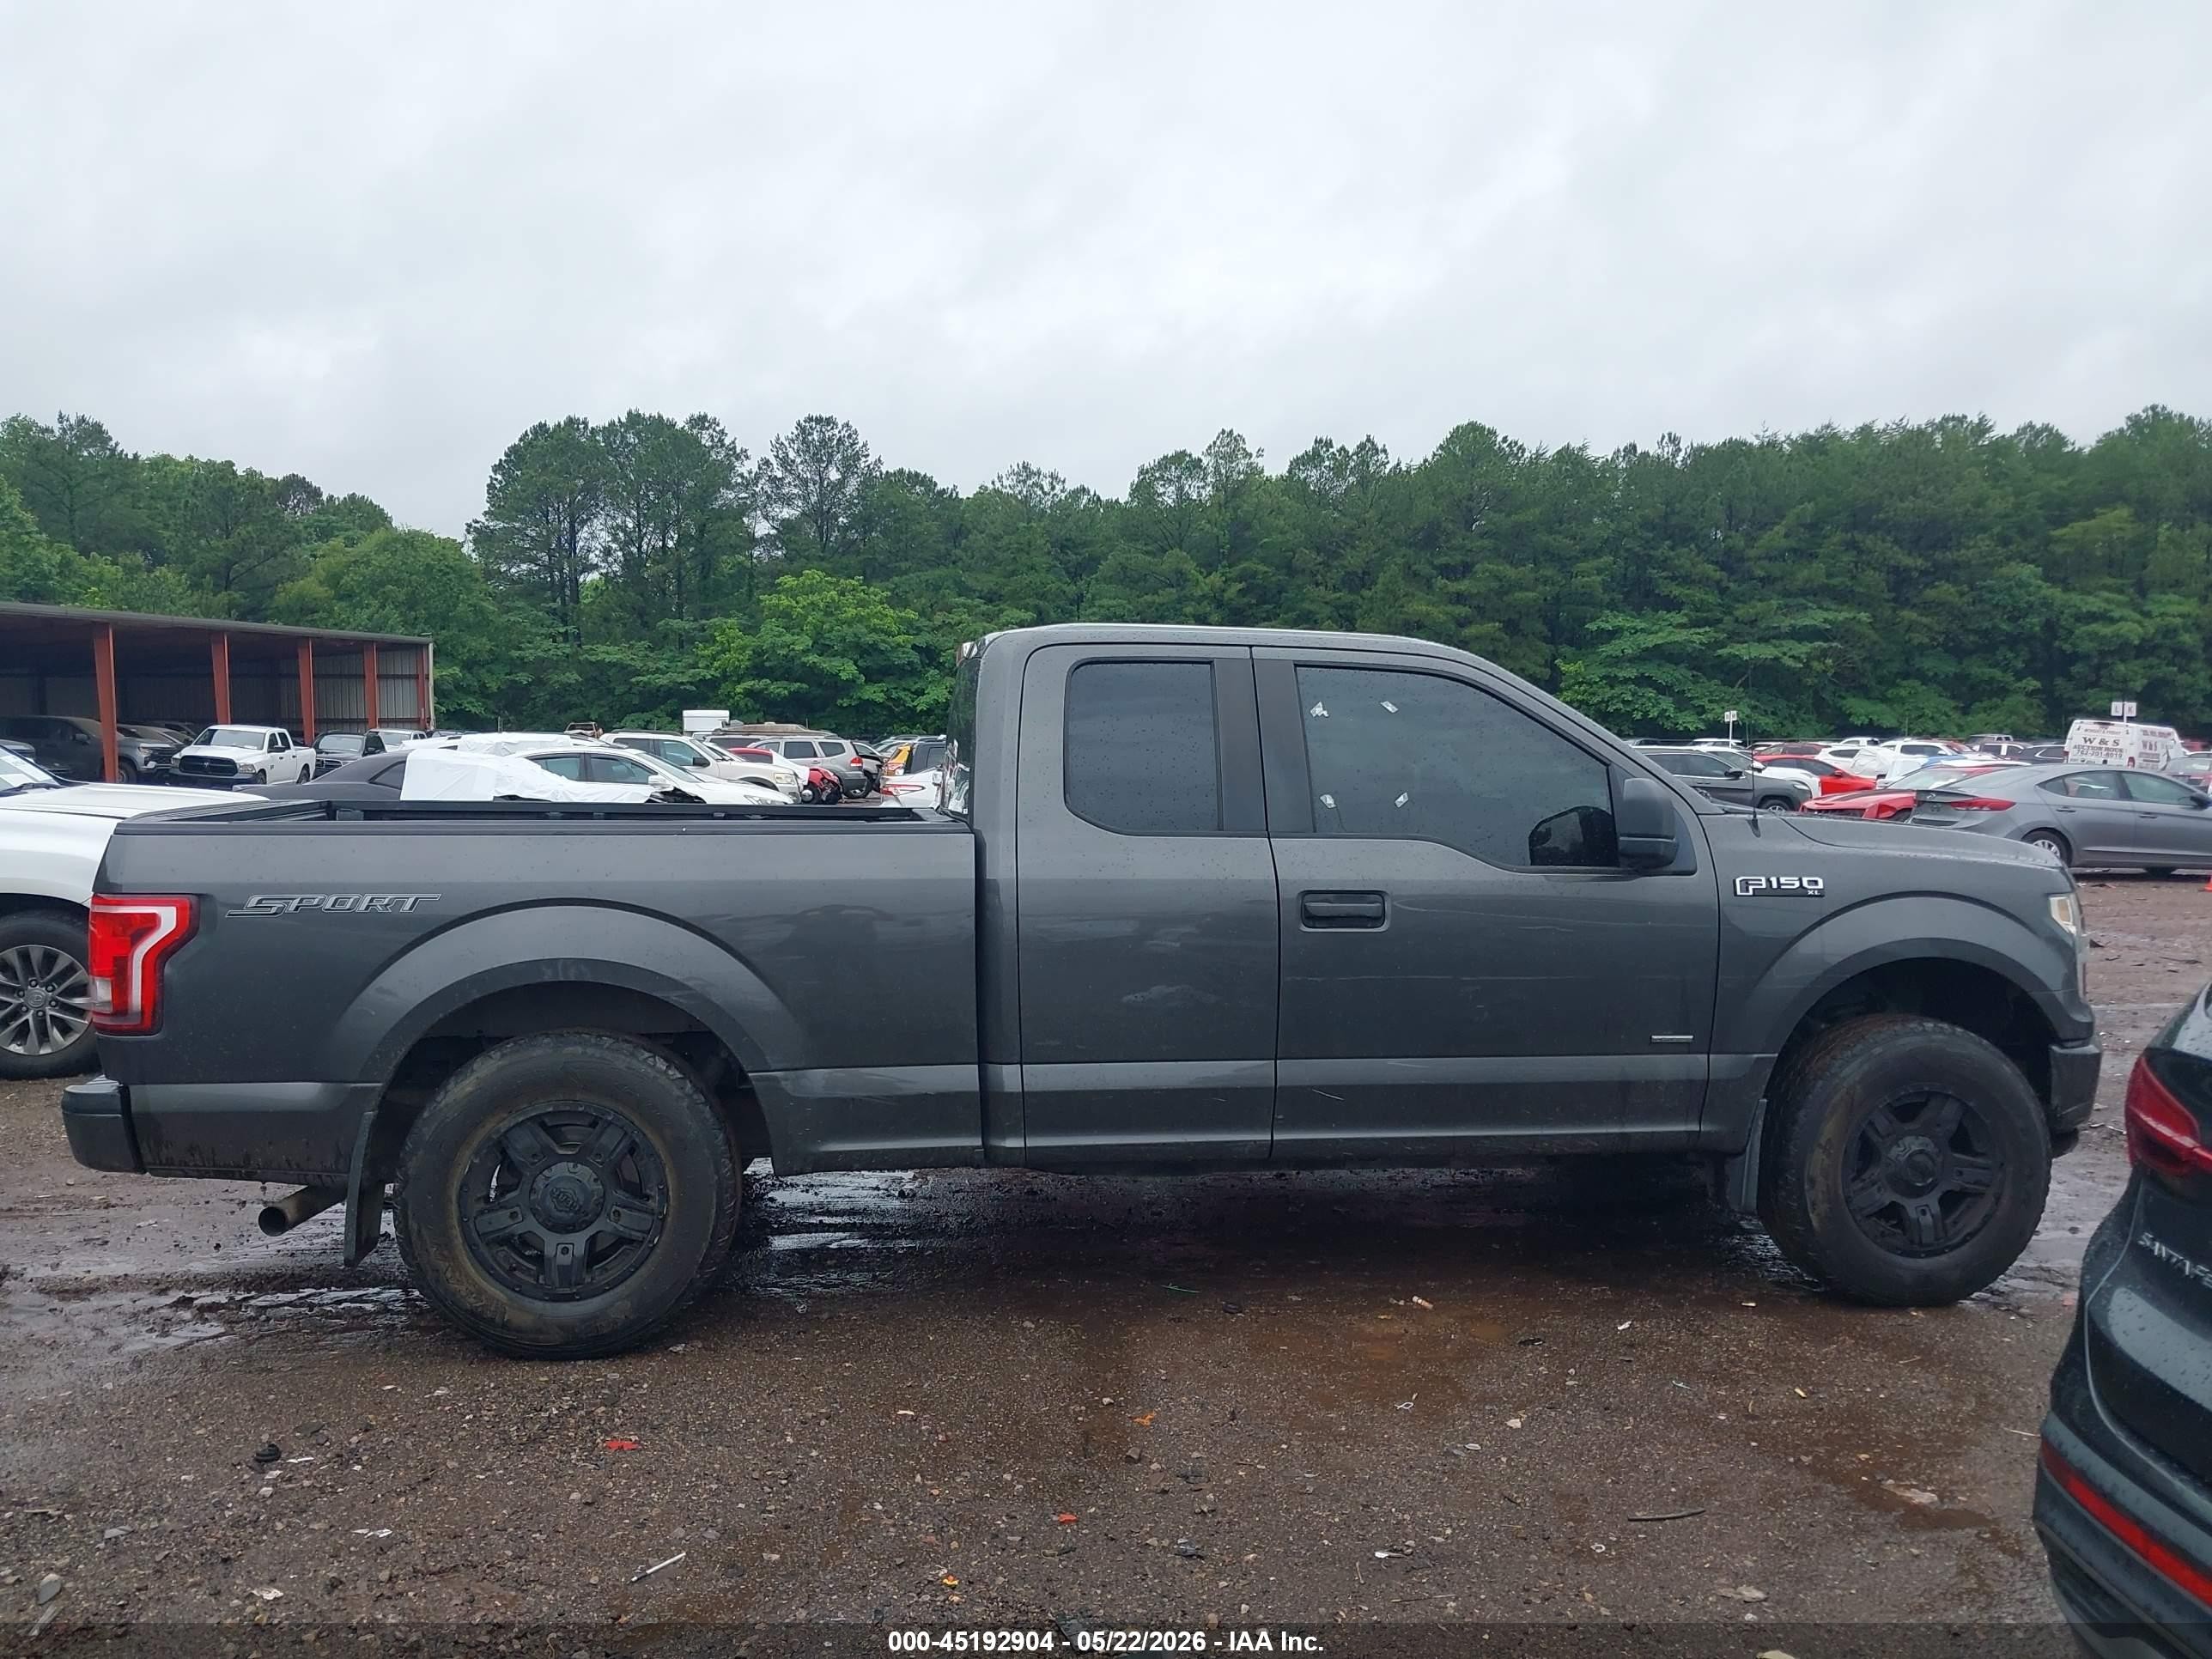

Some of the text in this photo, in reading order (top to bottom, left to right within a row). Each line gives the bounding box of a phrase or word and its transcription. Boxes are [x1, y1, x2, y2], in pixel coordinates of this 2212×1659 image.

[2082, 736, 2096, 744] W
[225, 894, 441, 917] SPORT
[2137, 1232, 2191, 1276] SANTA
